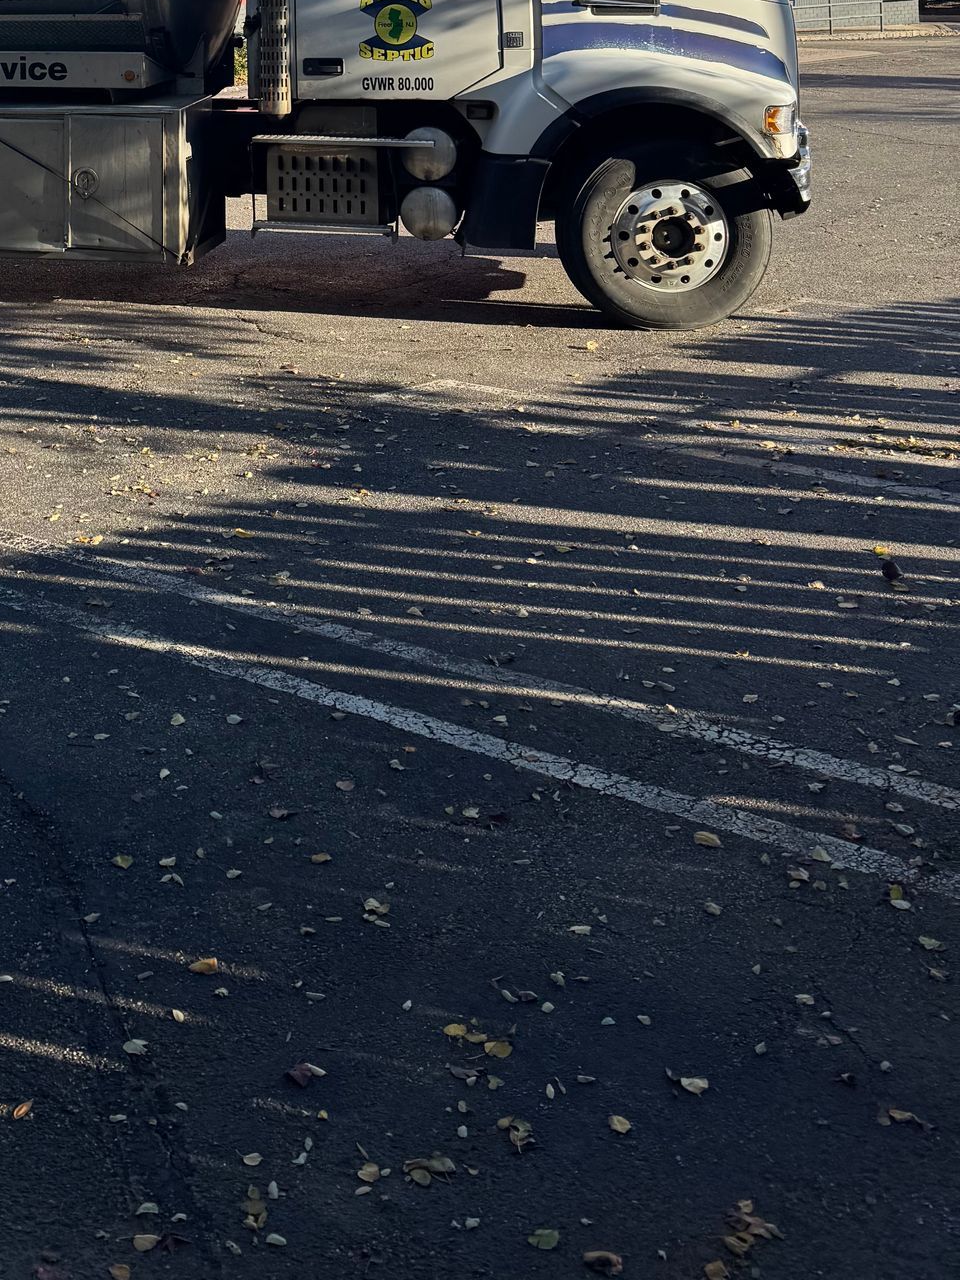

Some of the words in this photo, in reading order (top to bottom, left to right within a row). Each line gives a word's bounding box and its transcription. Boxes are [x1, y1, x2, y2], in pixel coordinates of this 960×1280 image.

[358, 42, 435, 62] SEPTIC
[361, 77, 395, 91] GVWR
[398, 76, 434, 92] 80,000
